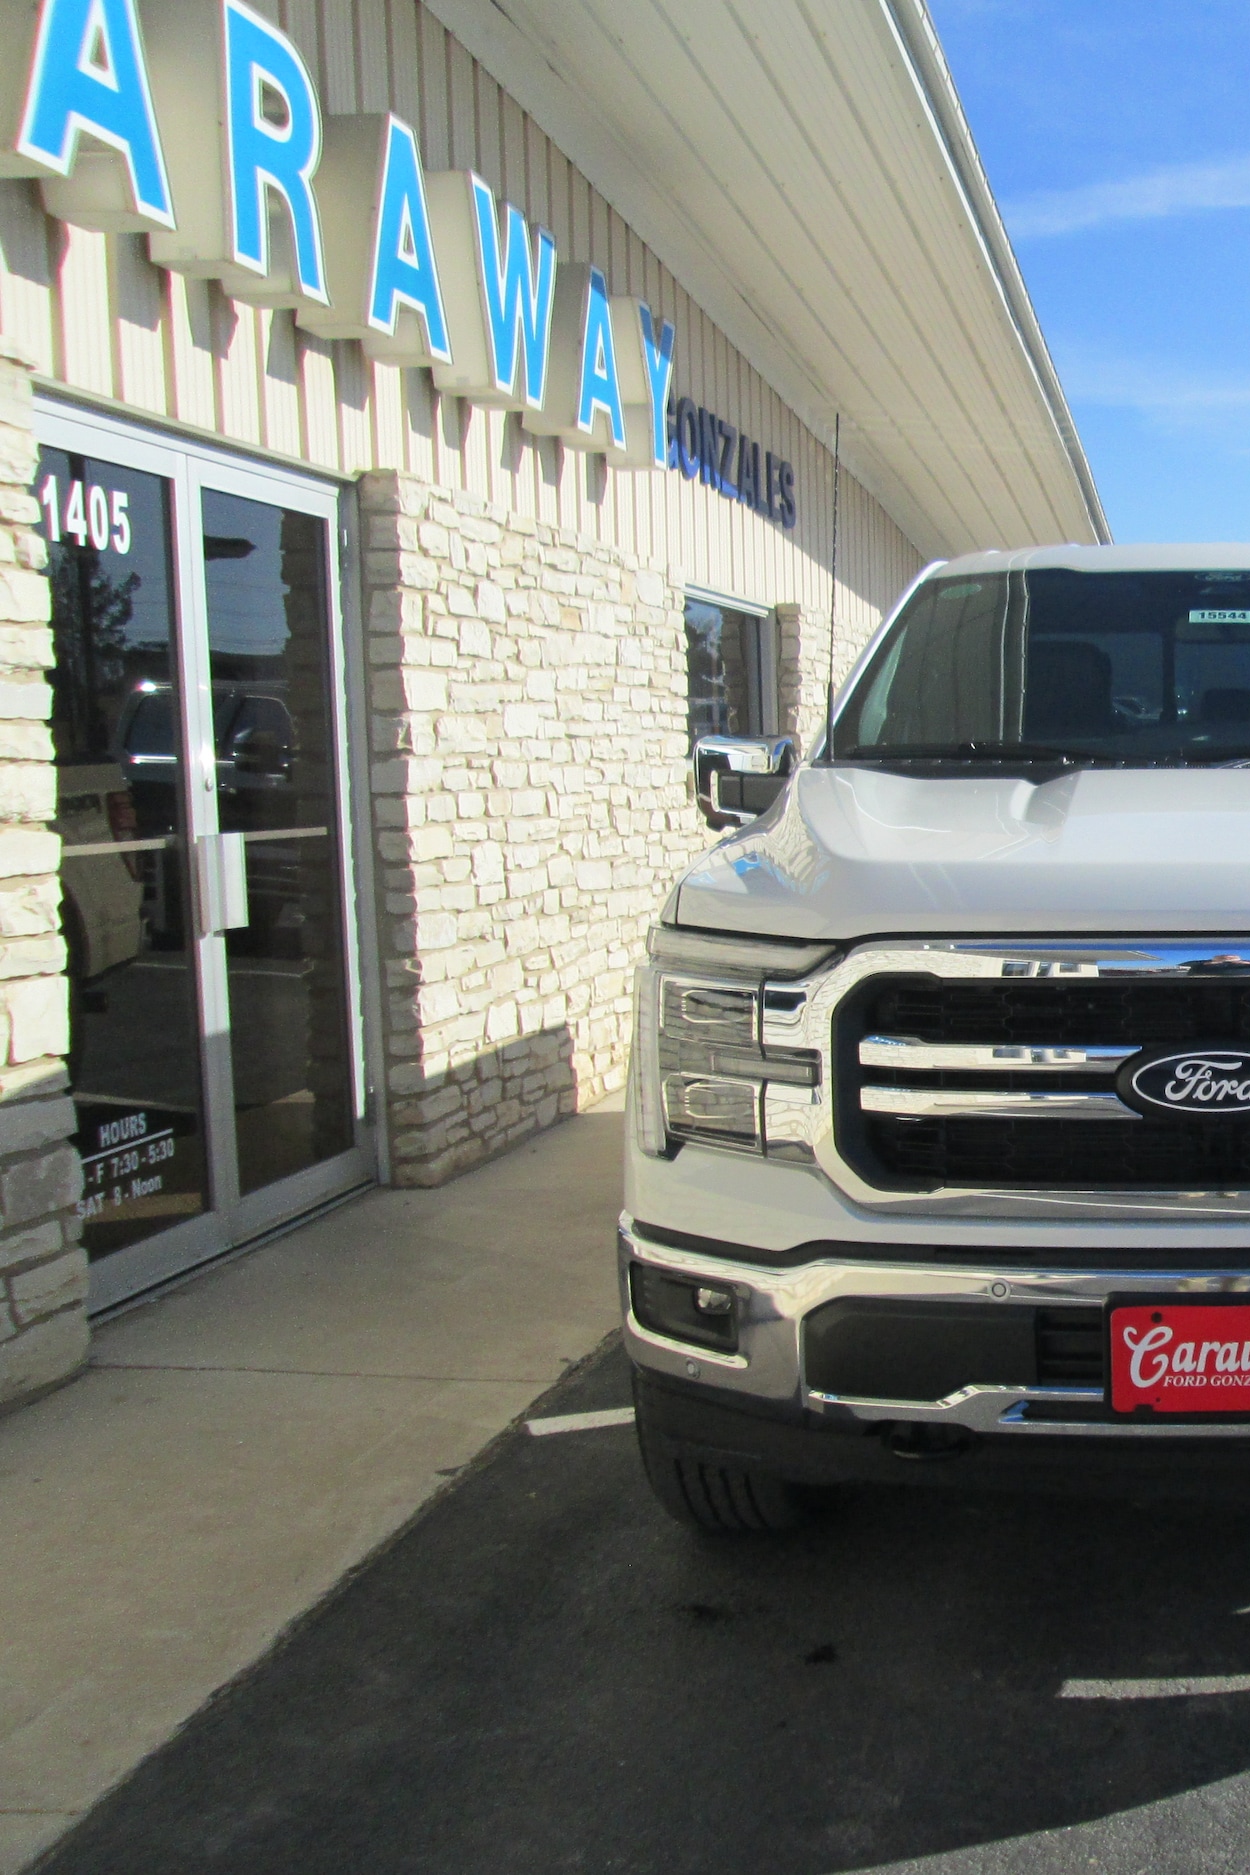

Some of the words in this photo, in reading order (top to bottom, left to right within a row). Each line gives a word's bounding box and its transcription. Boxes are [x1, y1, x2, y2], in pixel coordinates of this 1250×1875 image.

[42, 474, 131, 555] 1405
[1199, 611, 1247, 620] 15544
[99, 1112, 147, 1148] HOURS
[111, 1150, 139, 1178] 7:30
[148, 1138, 175, 1164] 5:30
[76, 1191, 105, 1219] SAT
[131, 1175, 162, 1199] Noon
[1163, 1374, 1207, 1387] FORD
